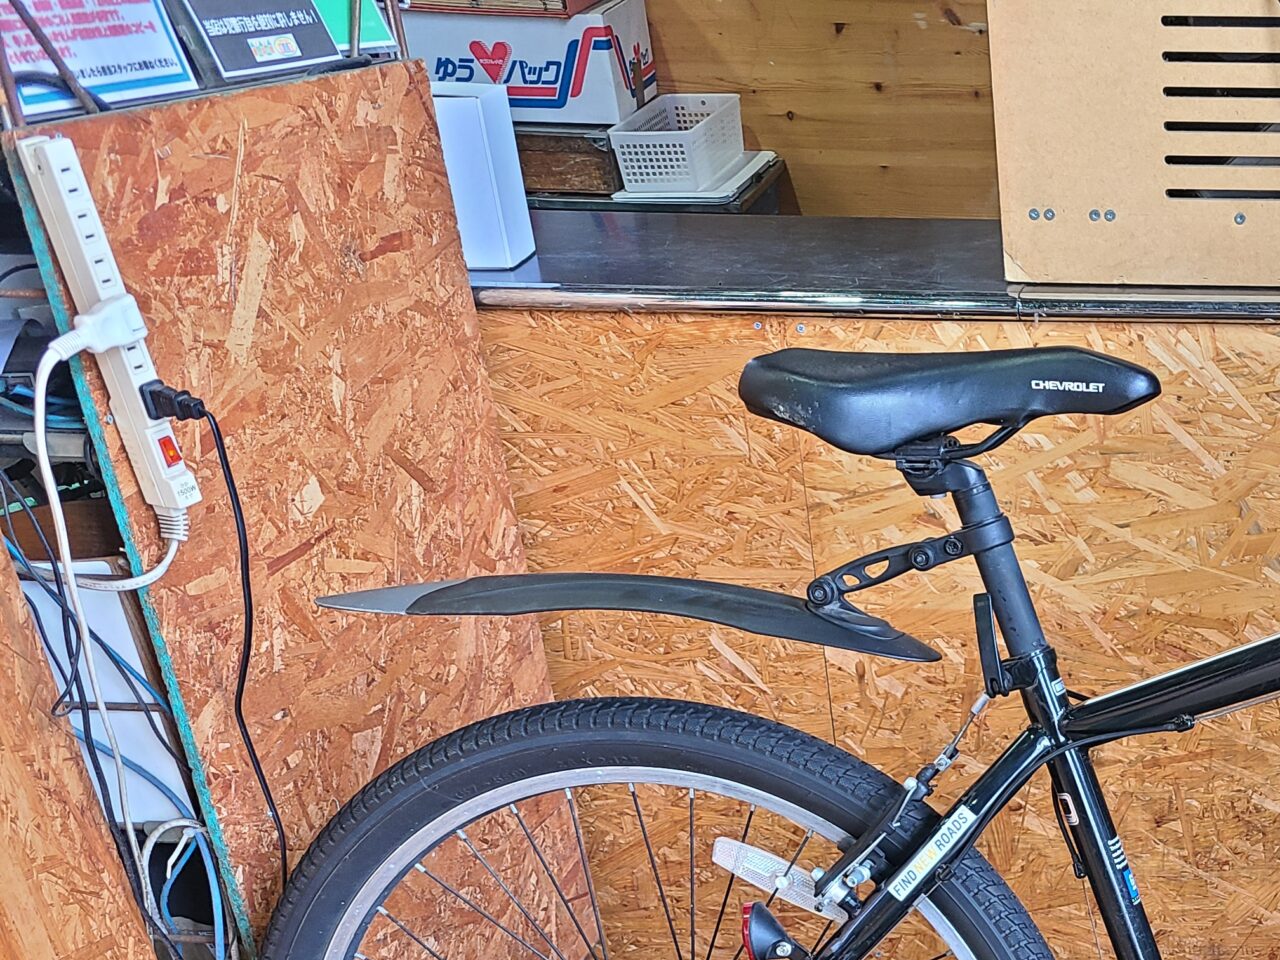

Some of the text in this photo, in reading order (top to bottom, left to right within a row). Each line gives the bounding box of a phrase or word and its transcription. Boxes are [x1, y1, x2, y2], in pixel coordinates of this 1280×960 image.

[503, 60, 561, 85] パック
[1031, 380, 1105, 393] CHEVROLET
[892, 811, 969, 897] FIND NEW ROADS
